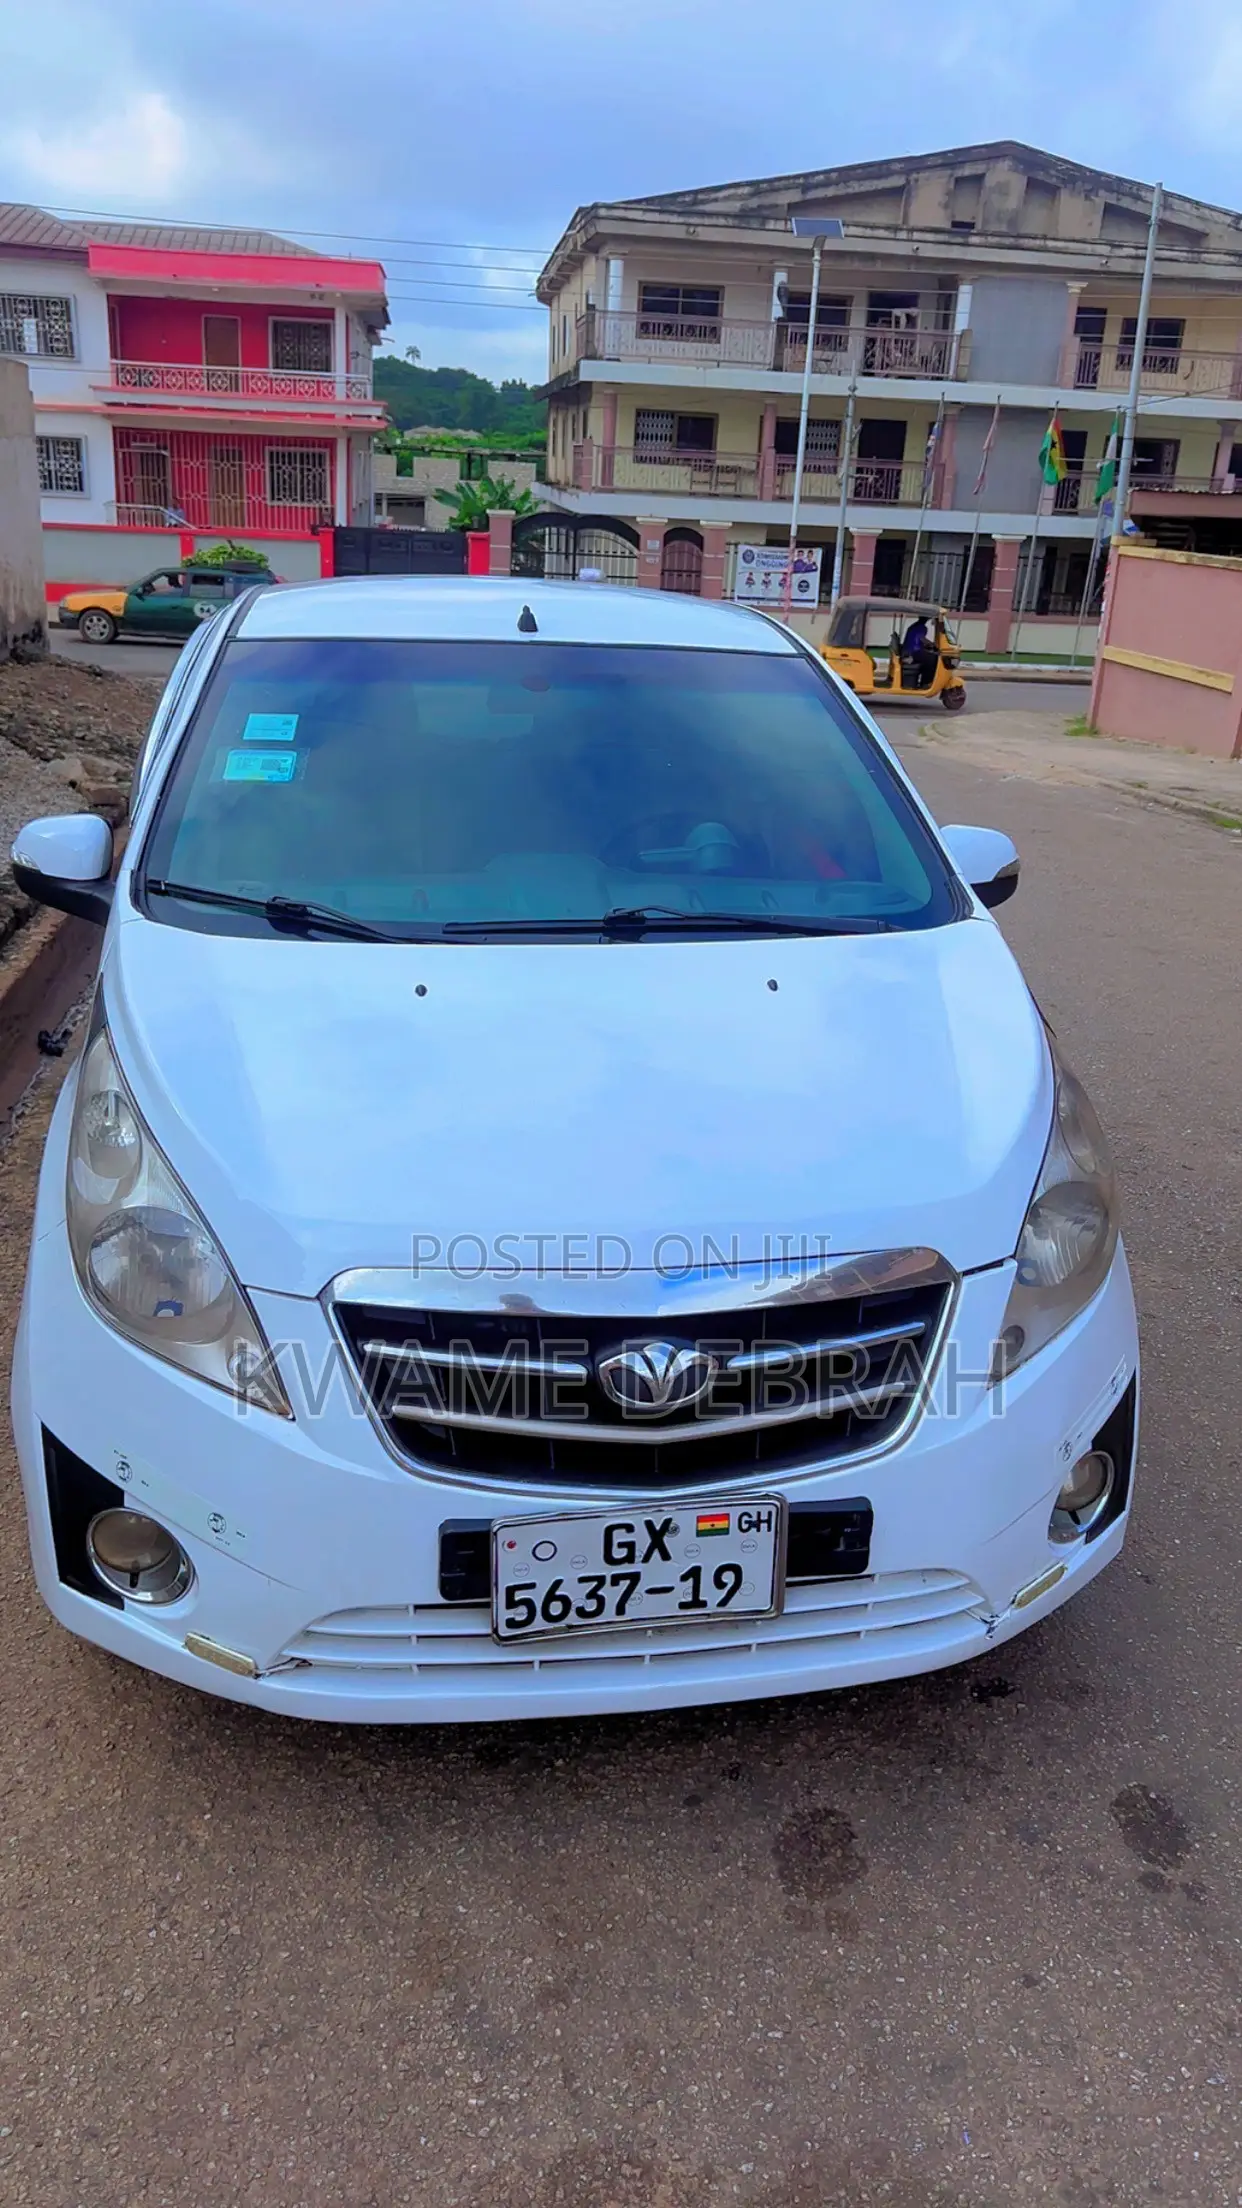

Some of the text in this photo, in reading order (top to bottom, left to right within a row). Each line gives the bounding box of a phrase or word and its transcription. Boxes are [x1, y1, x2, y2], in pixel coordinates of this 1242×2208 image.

[603, 1510, 772, 1566] GX GH
[505, 1563, 744, 1629] 5637-19
